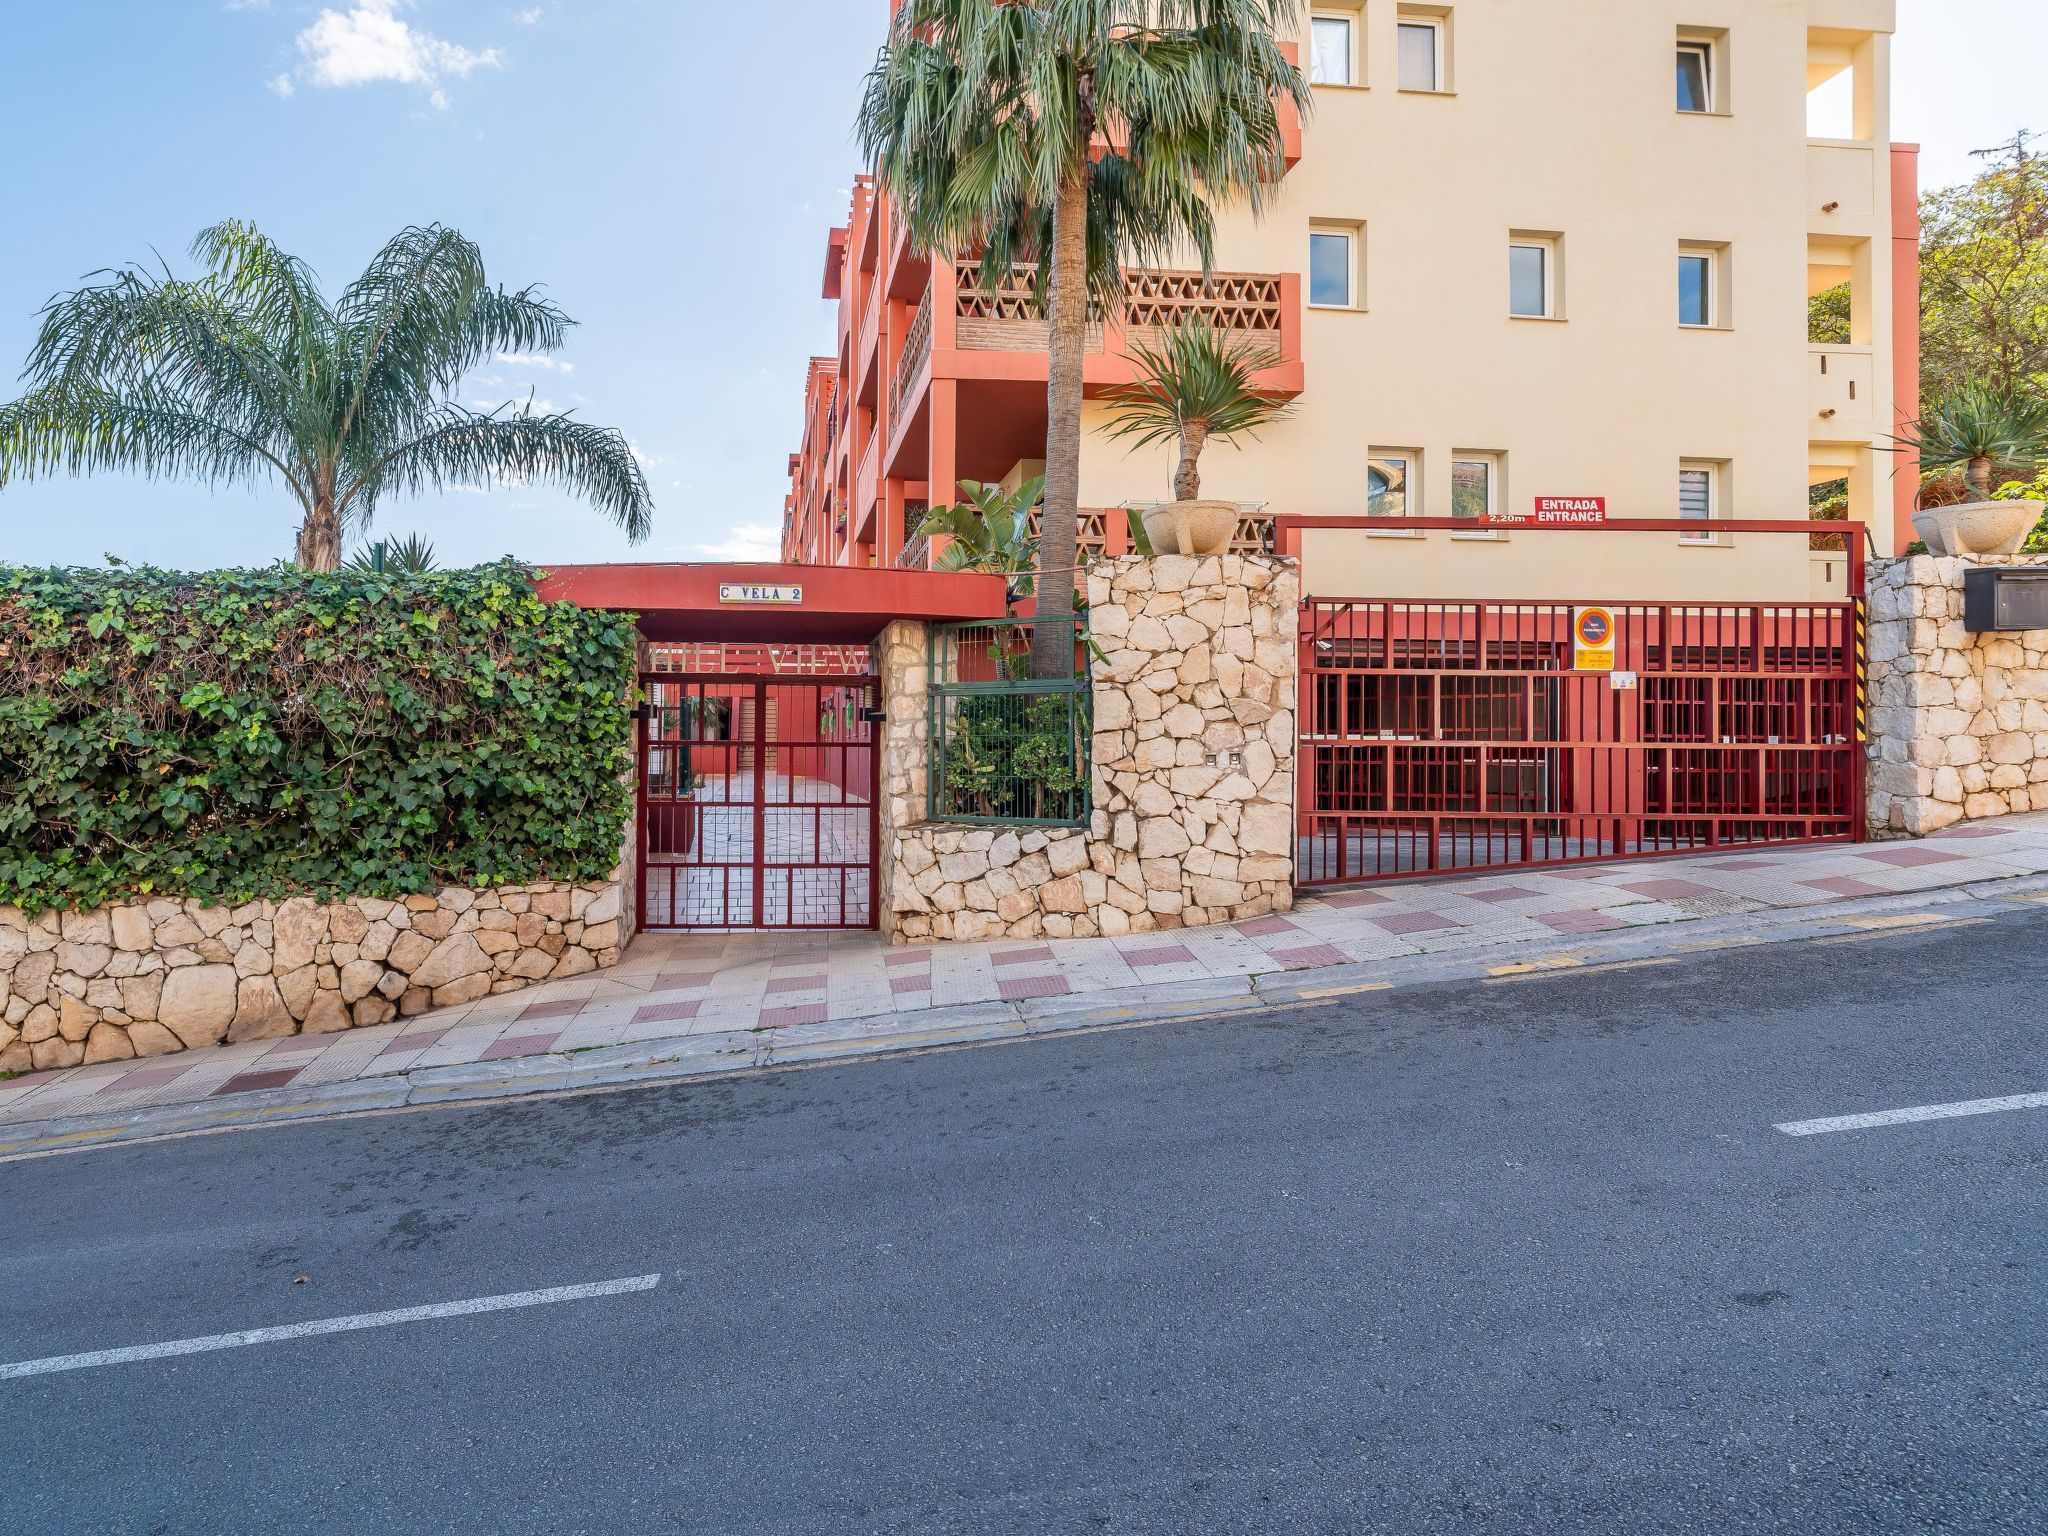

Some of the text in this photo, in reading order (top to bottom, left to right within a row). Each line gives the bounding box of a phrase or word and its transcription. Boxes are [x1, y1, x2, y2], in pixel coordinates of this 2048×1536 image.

[1541, 499, 1598, 510] ENTRADA
[1489, 514, 1526, 523] 2,20m
[1538, 511, 1603, 522] ENTRANCE
[720, 587, 801, 599] C VELA 2
[649, 642, 870, 676] HILL VIEW
